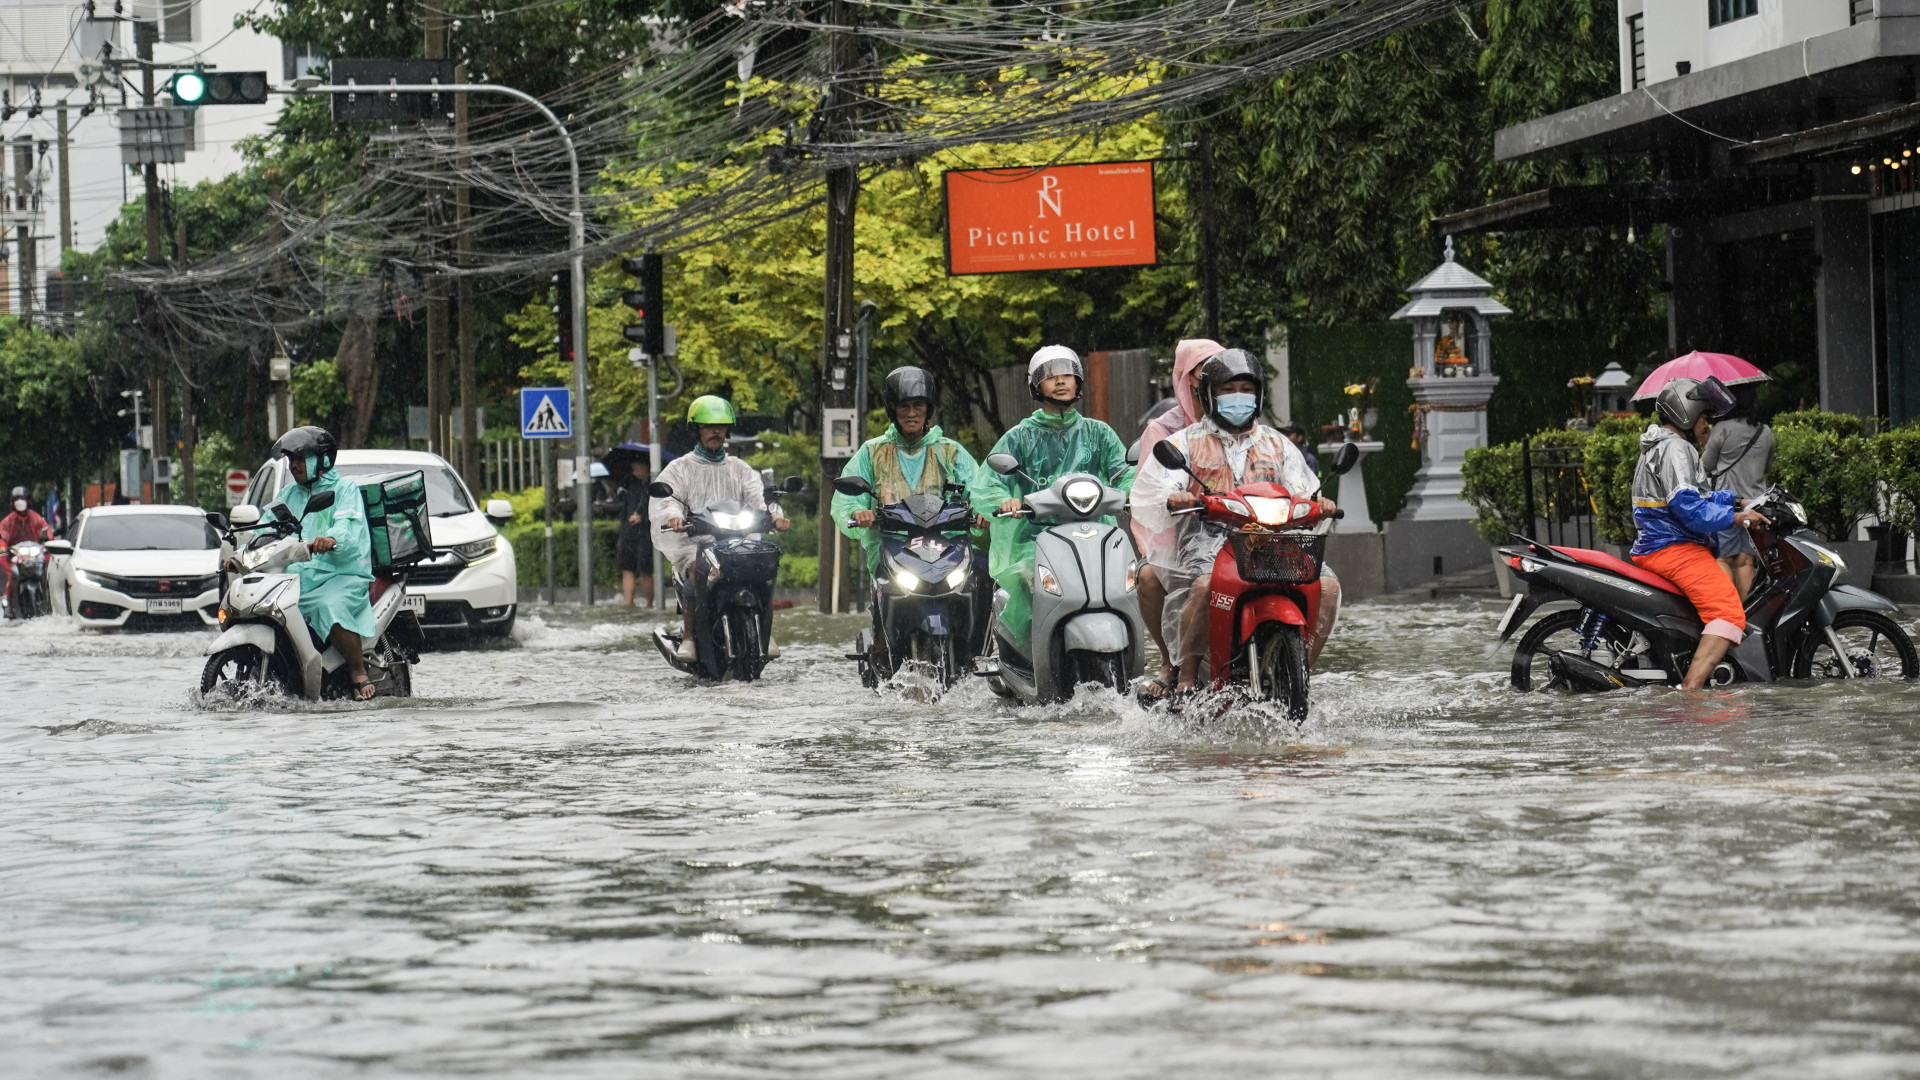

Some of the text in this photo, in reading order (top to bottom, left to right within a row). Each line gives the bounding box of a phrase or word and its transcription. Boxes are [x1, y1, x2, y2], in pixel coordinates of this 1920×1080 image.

[968, 220, 1136, 247] Picnic Hotel
[1018, 250, 1089, 262] BANGKOK
[1210, 591, 1235, 607] YSS
